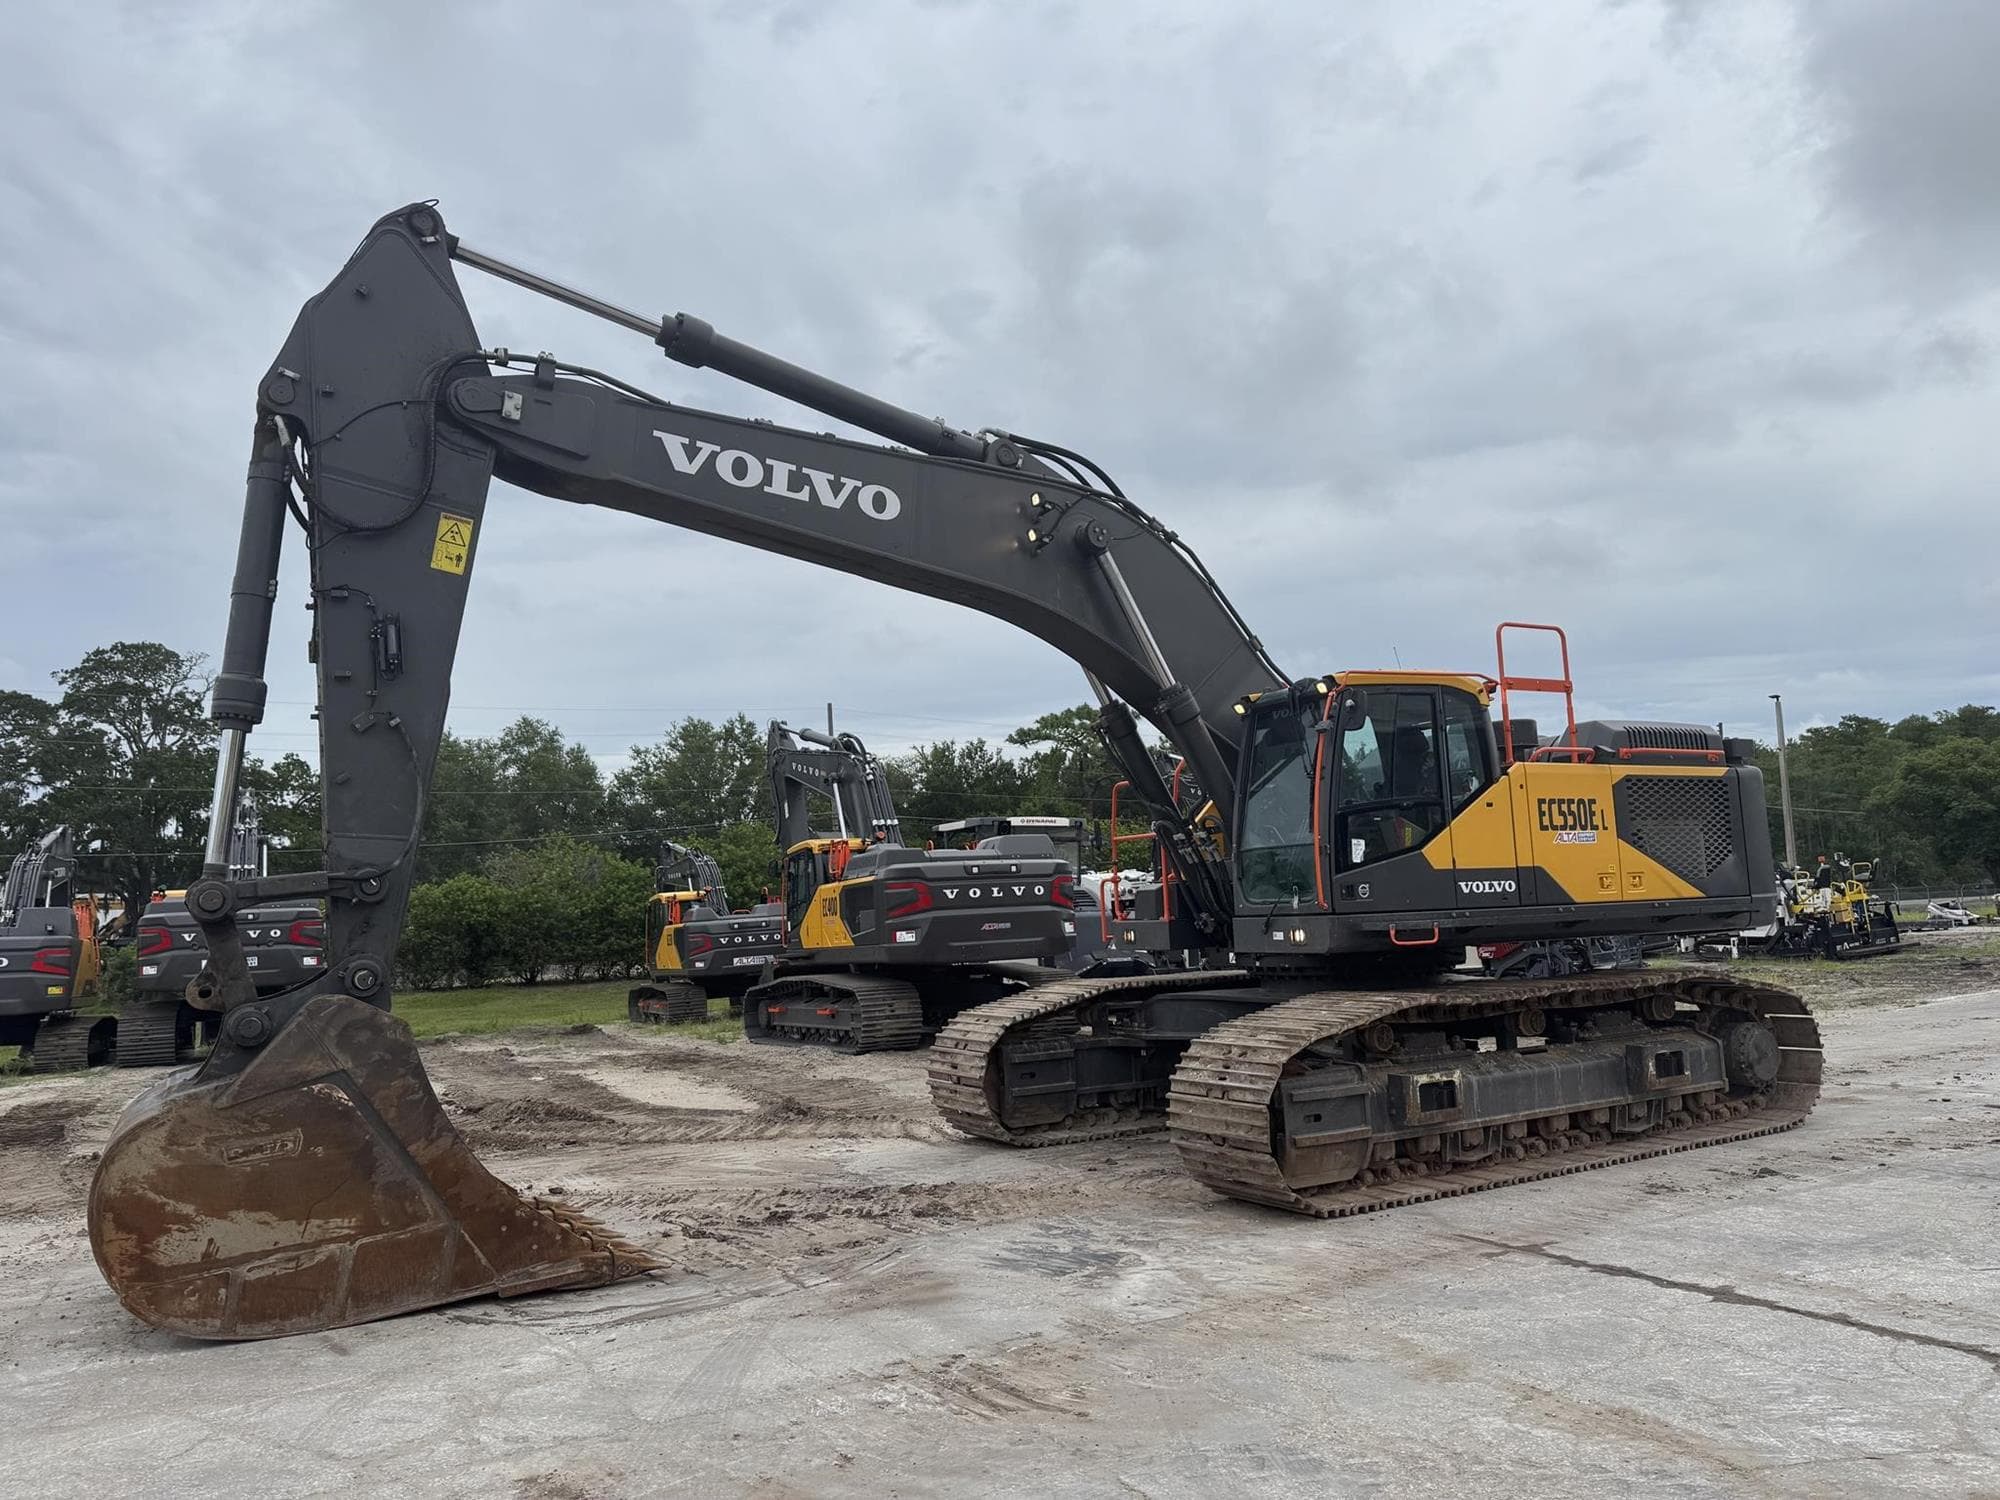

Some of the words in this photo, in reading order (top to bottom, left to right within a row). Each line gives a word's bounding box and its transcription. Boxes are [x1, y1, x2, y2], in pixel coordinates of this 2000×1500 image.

[652, 430, 901, 521] VOLVO
[791, 762, 820, 777] VOLVO
[1537, 797, 1600, 831] EC550E
[1554, 831, 1578, 843] ALTA
[943, 885, 1045, 900] VOLVO
[1457, 880, 1517, 894] VOLVO
[181, 929, 281, 942] VVO
[719, 933, 782, 945] VOLVO
